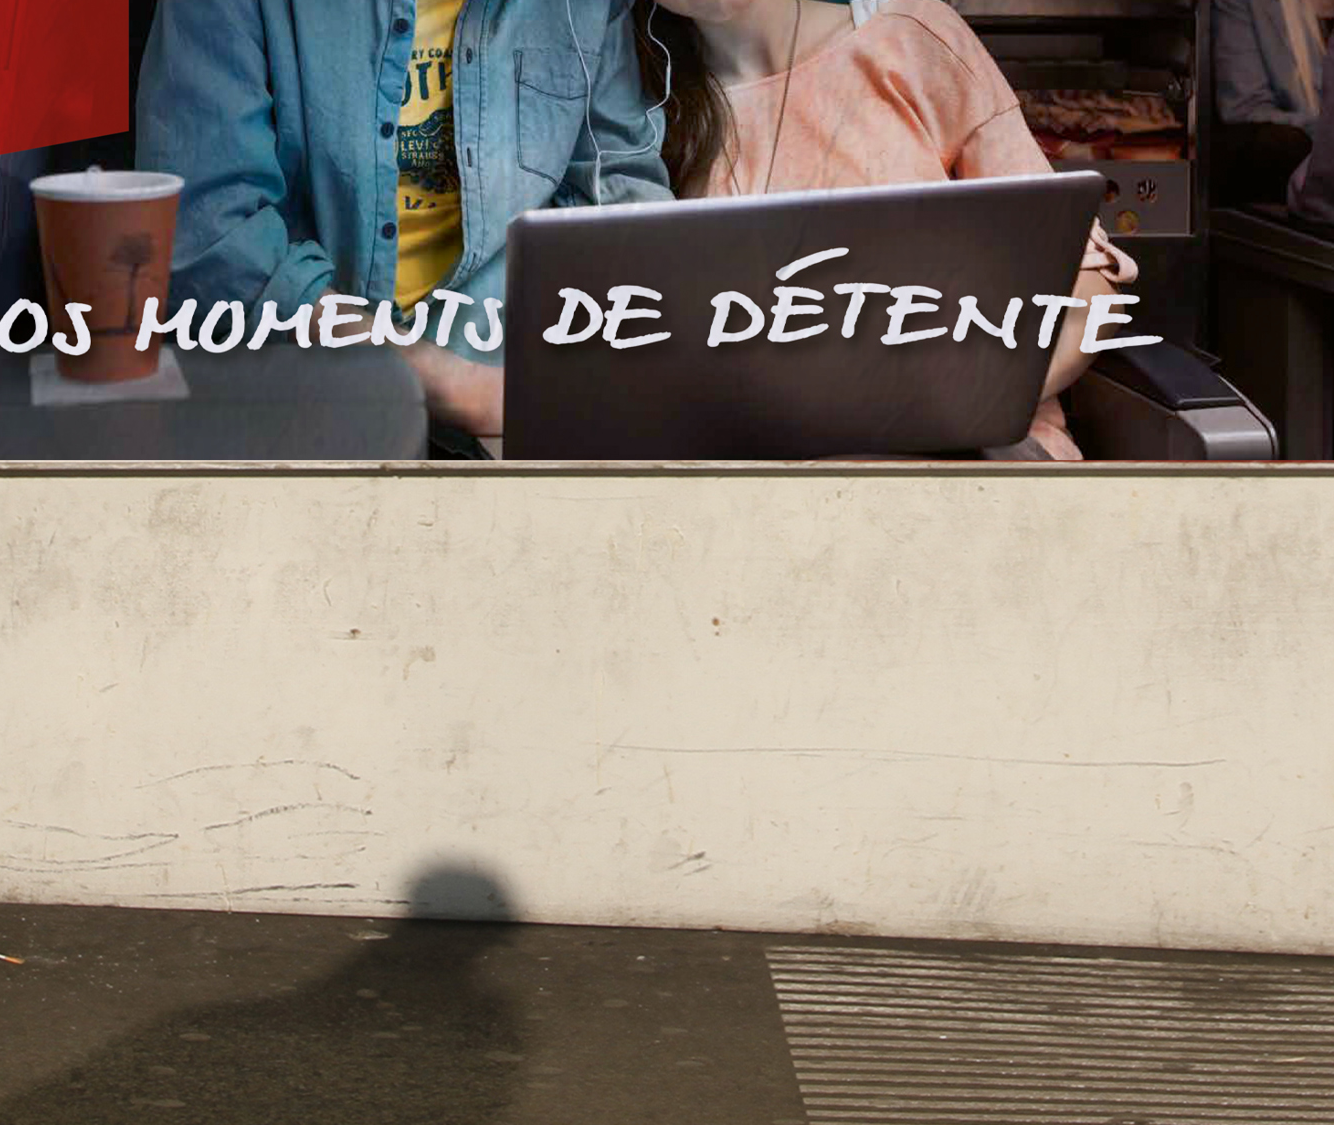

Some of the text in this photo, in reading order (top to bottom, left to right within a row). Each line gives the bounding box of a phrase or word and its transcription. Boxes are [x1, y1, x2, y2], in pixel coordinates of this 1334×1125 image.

[135, 288, 504, 354] MOMENTS
[542, 285, 672, 350] DE
[707, 246, 1164, 354] DÉTENTE
